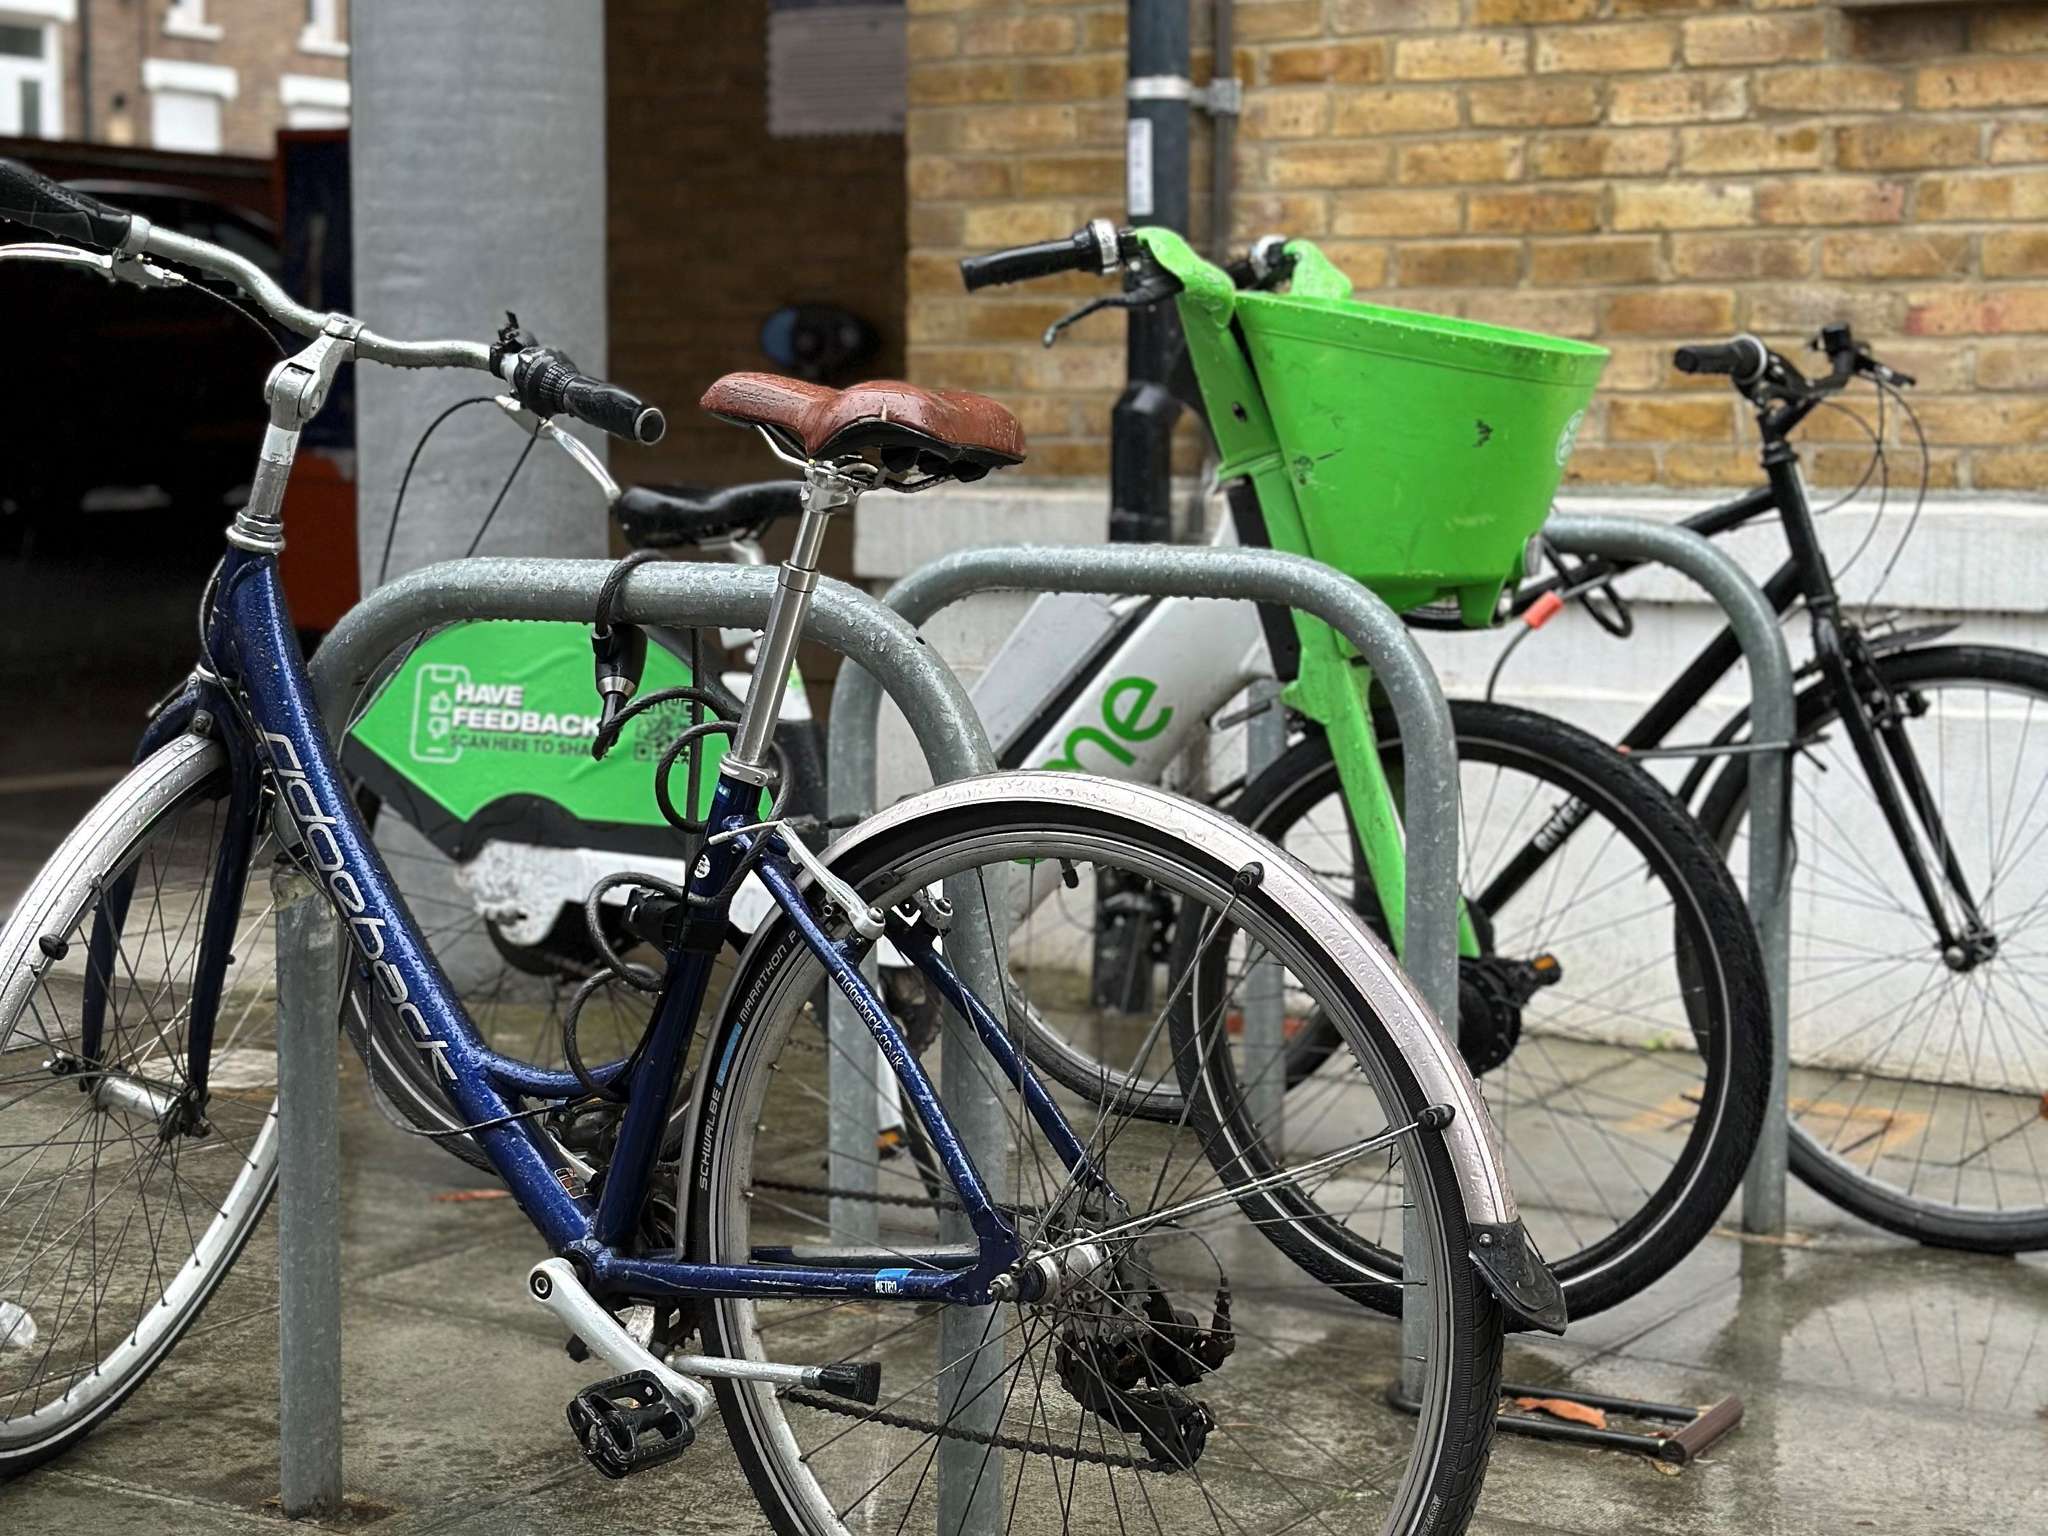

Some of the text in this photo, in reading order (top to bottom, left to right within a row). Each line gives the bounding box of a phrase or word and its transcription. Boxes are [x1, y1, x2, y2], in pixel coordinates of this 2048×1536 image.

[455, 683, 522, 706] HAVE
[451, 735, 594, 757] SCAN HERE TO SHA
[264, 732, 460, 1086] ridgeback
[739, 943, 788, 1023] MARATHON
[836, 969, 904, 1072] ridgeback.co.uk
[700, 1086, 721, 1192] SCHWALBE
